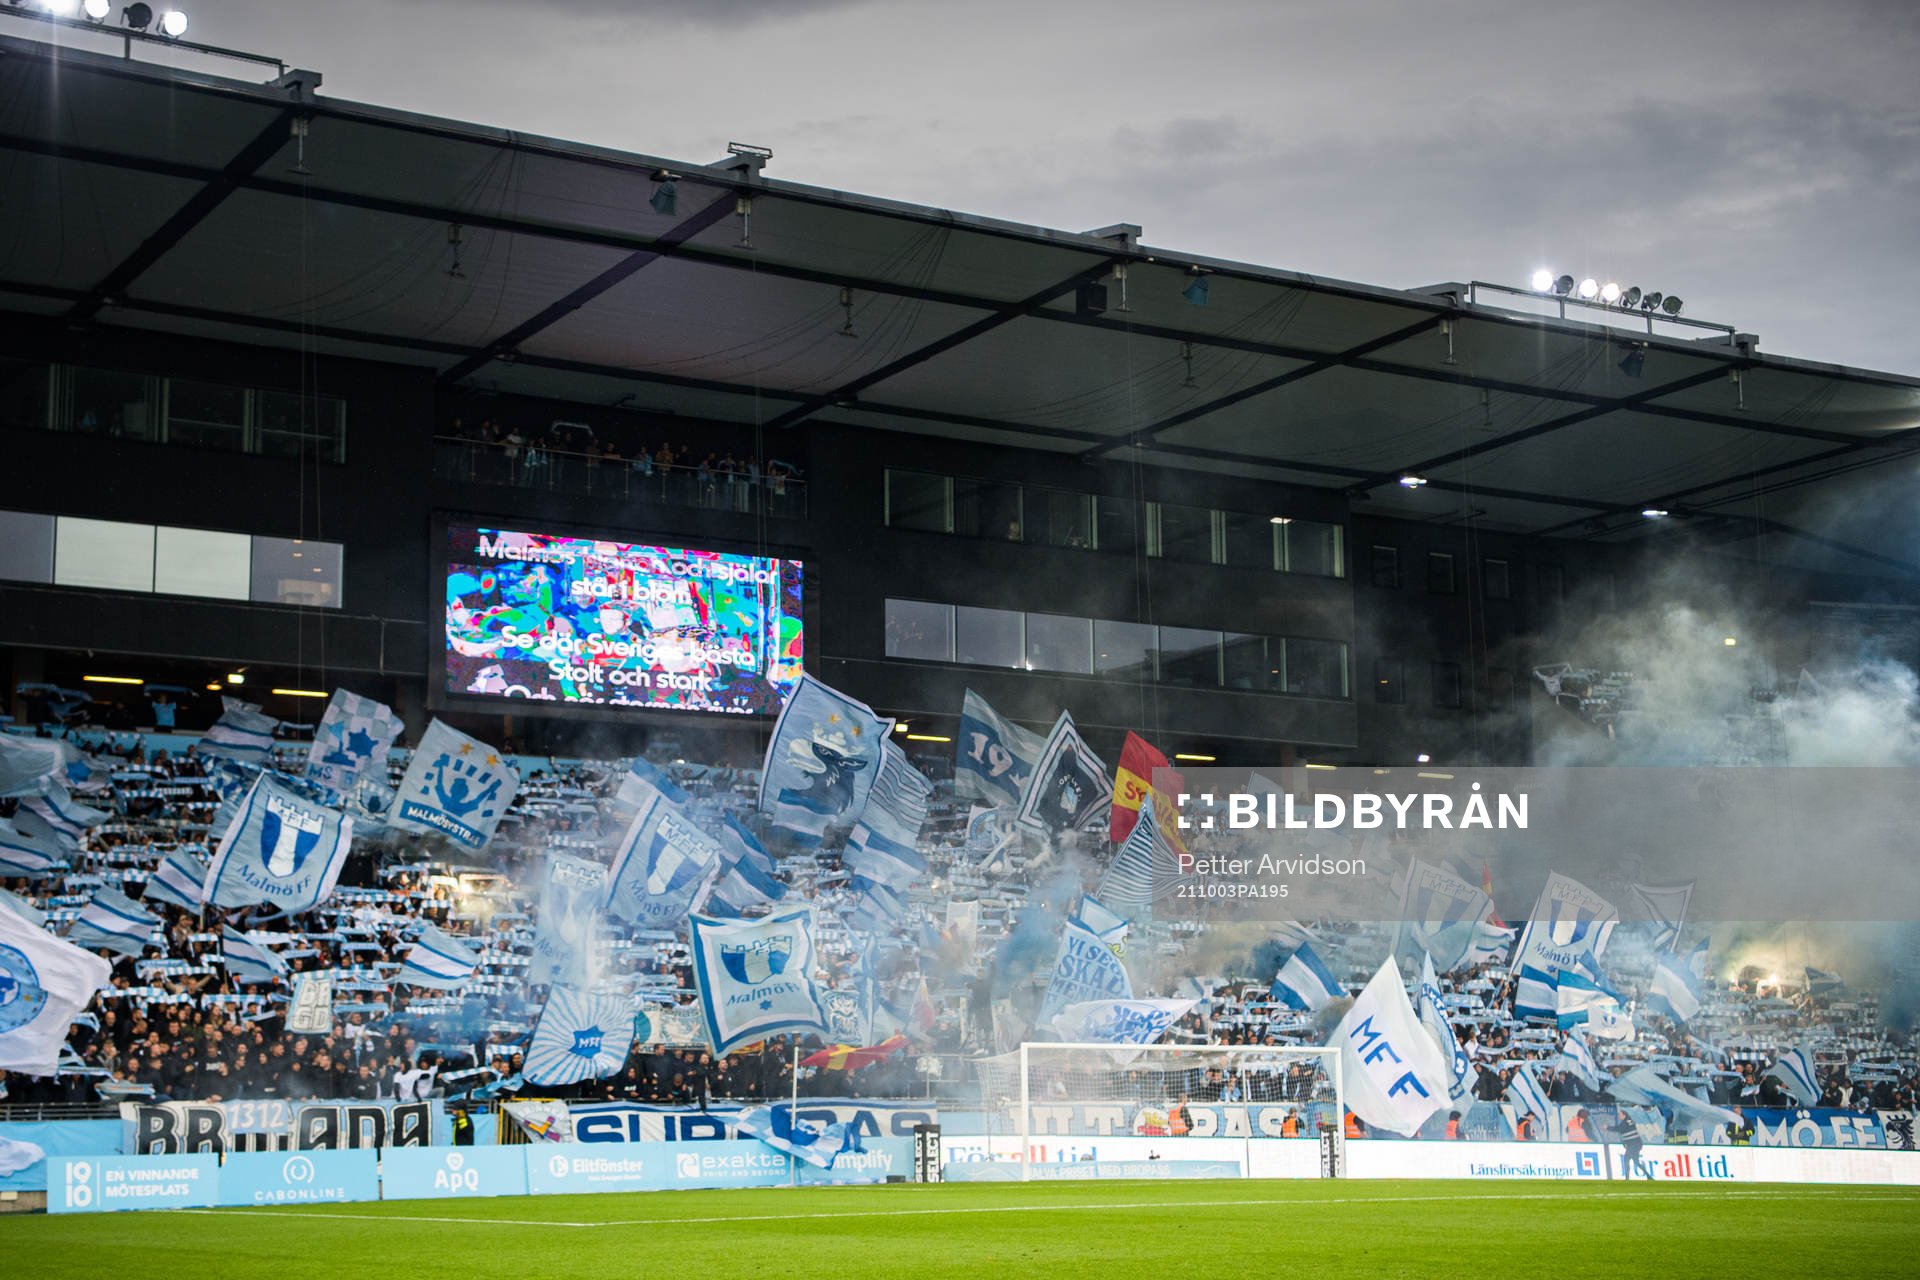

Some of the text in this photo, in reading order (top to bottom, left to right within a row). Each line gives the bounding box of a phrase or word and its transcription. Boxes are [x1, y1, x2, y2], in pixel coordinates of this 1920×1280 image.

[501, 625, 534, 649] Se
[539, 629, 584, 656] där
[548, 659, 713, 692] Stolt och stark
[236, 863, 293, 896] Malmö
[727, 983, 784, 1007] Malmö
[1350, 1015, 1430, 1099] MFF
[230, 1103, 285, 1129] 1312
[573, 1157, 643, 1174] Elitfönster
[702, 1152, 786, 1169] exakta
[926, 1132, 940, 1183] SELECT
[1664, 1153, 1692, 1178] all
[1697, 1154, 1735, 1178] tid.
[106, 1168, 199, 1182] EN VINNANDE
[434, 1168, 479, 1192] ApQ
[1470, 1161, 1575, 1179] Länsförsäkringar
[106, 1183, 189, 1198] MÖTESPLATS
[254, 1187, 345, 1201] CABONLINE
